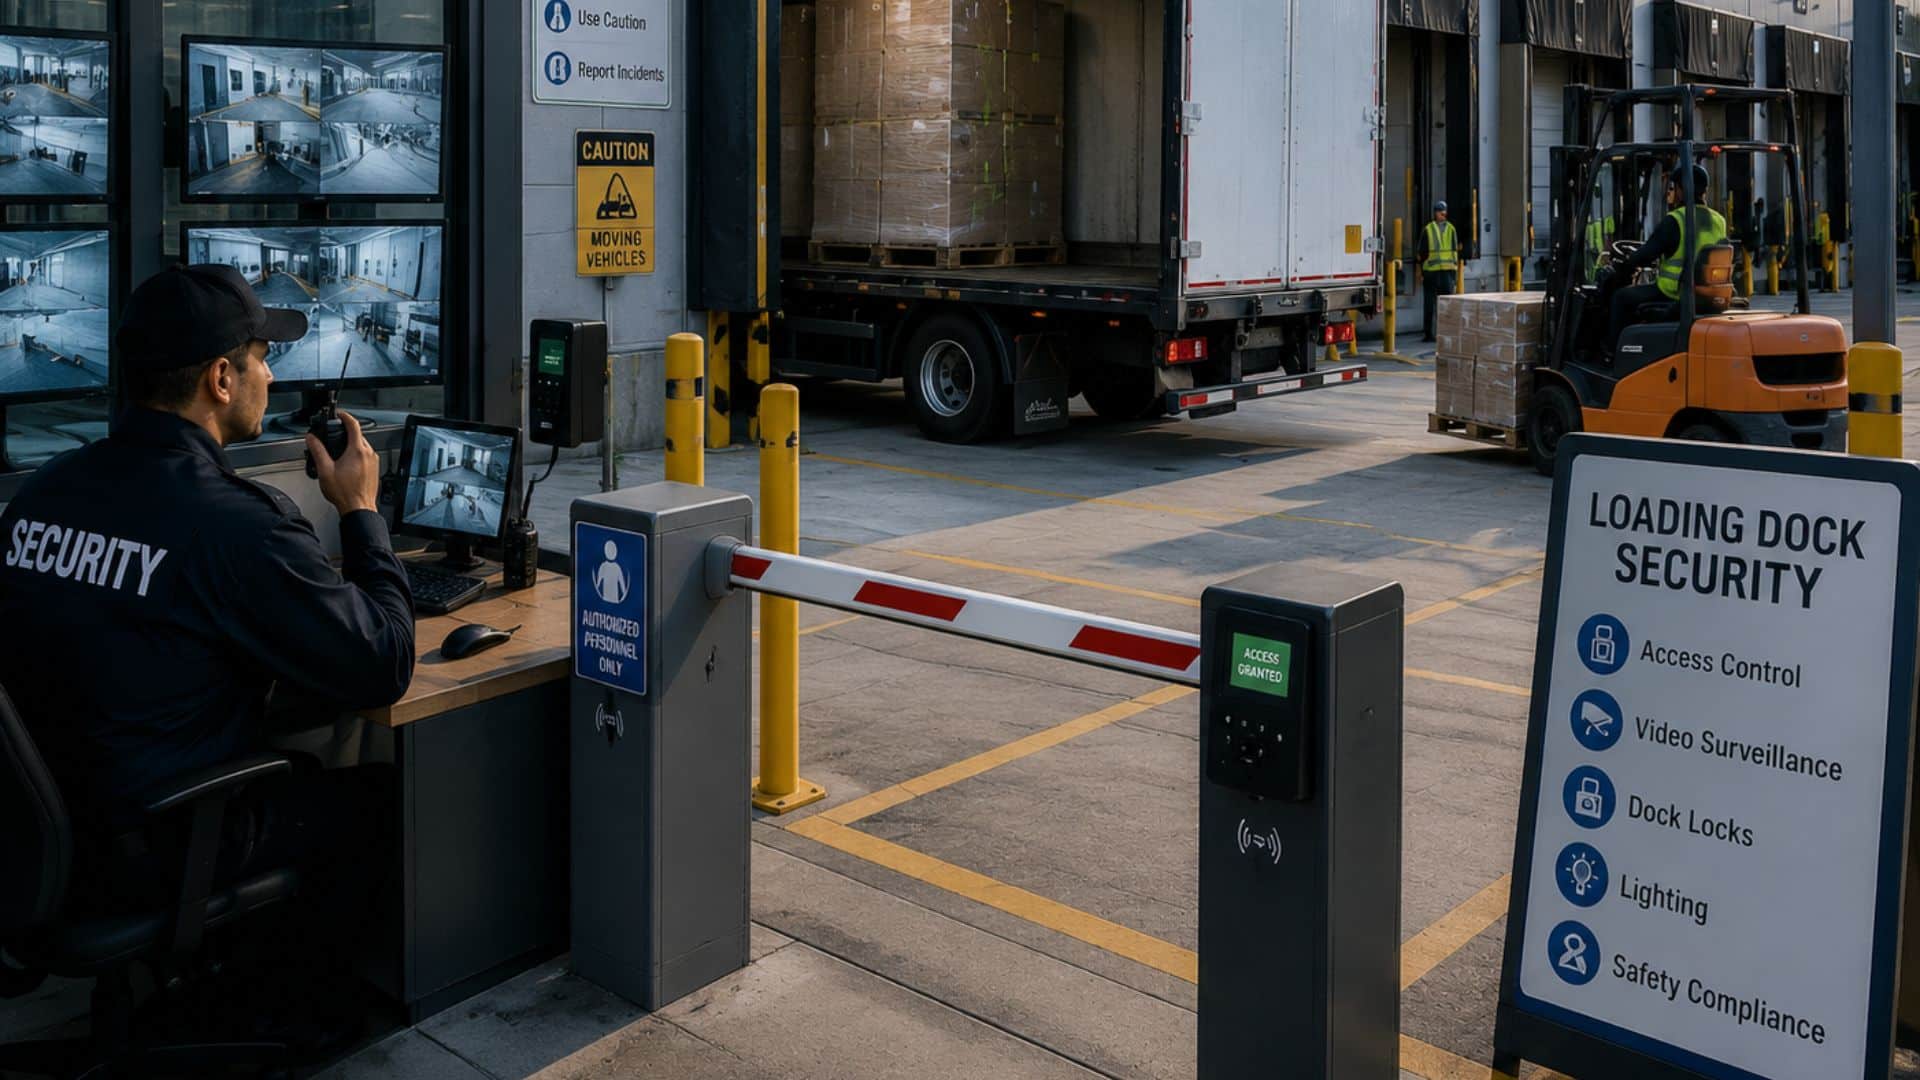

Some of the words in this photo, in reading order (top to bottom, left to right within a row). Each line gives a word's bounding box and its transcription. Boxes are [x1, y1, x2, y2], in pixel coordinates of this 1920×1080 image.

[578, 9, 600, 27] Use
[603, 11, 647, 31] Caution
[578, 61, 615, 81] Report
[617, 64, 665, 83] Incidents
[582, 140, 649, 161] CAUTION
[586, 250, 646, 268] VEHICLES
[591, 230, 642, 247] MOVING
[1589, 491, 1745, 544] LOADING
[1756, 509, 1867, 560] DOCK
[6, 518, 168, 597] SECURITY
[1614, 542, 1824, 610] SECURITY
[1238, 663, 1282, 683] GRANTED
[1244, 648, 1280, 664] ACCESS
[1639, 639, 1714, 673] Access
[1720, 652, 1802, 688] Control
[1634, 716, 1694, 750] Video
[1700, 730, 1843, 782] Surveillance
[1628, 795, 1681, 830] Dock
[1688, 809, 1754, 847] Locks
[1620, 874, 1709, 926] Lighting
[1612, 954, 1682, 1001] Safety
[1687, 978, 1826, 1045] Compliance
